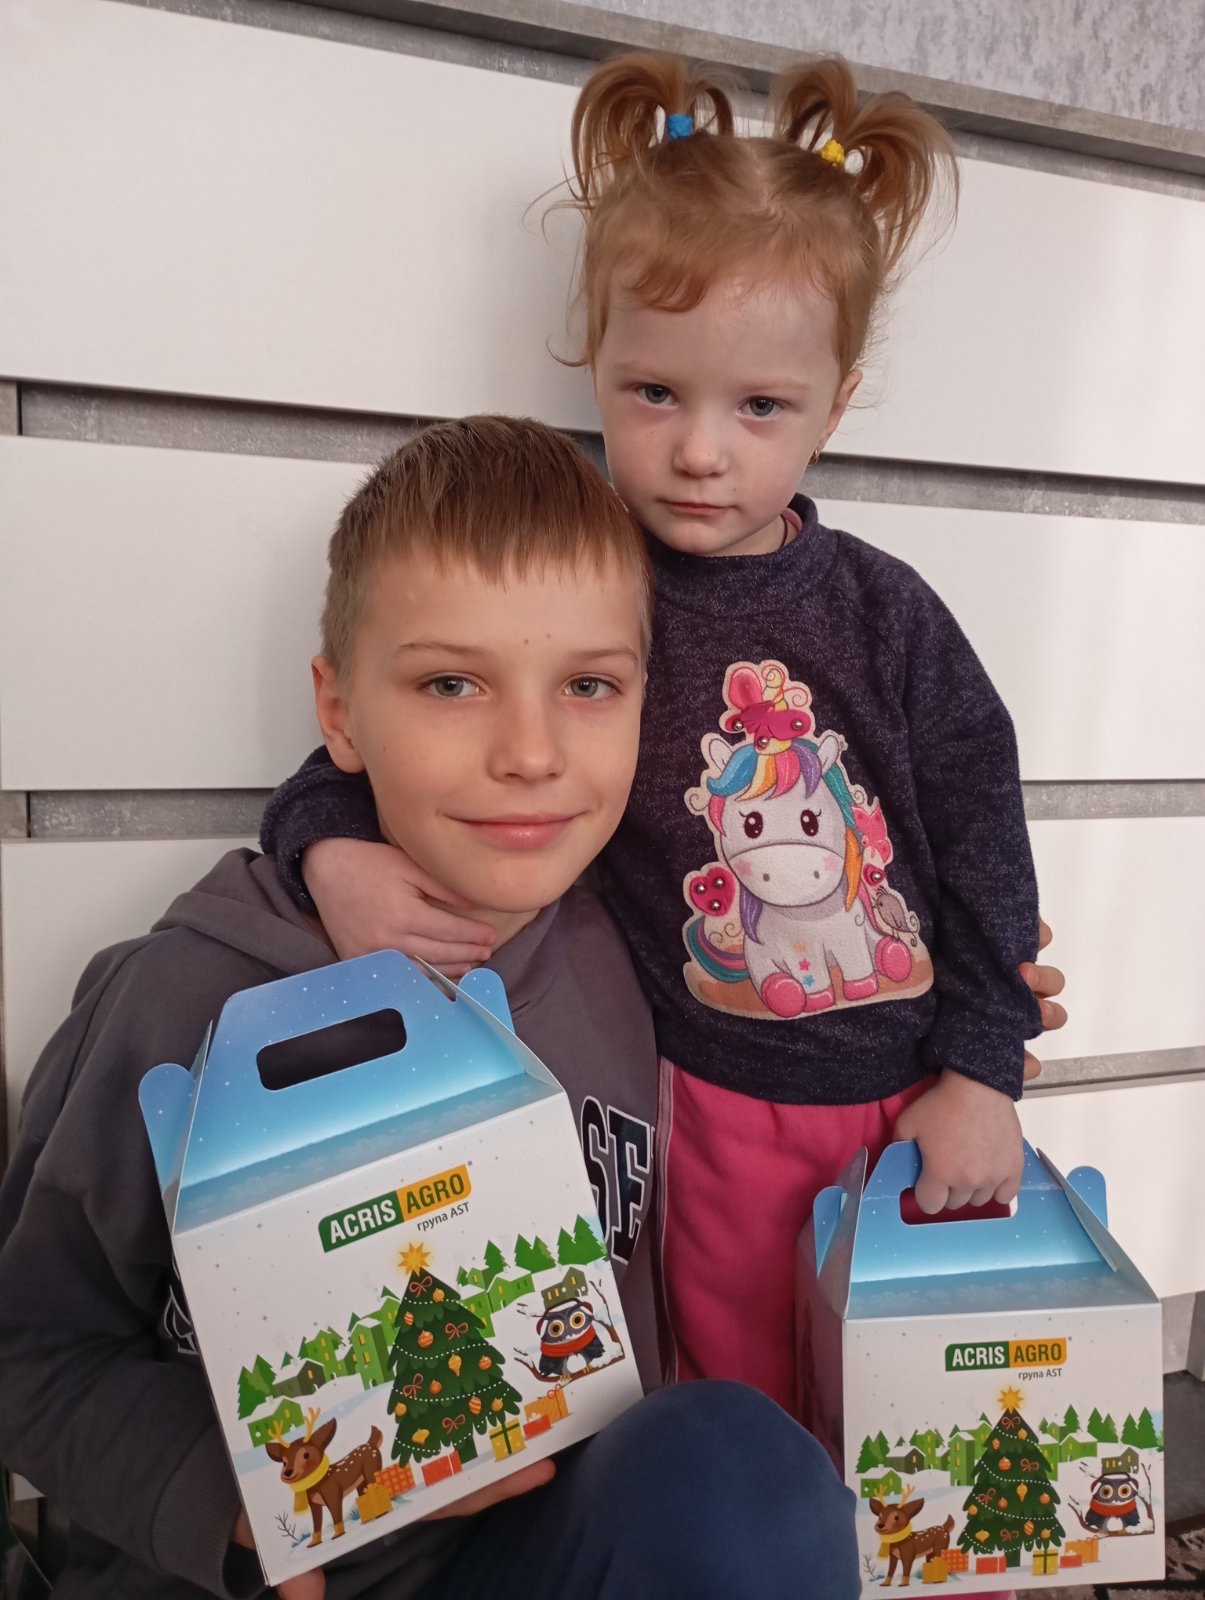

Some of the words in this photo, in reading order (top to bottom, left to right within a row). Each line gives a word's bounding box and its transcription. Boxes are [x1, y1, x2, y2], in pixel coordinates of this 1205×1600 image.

[330, 1199, 397, 1244] ACRIS
[406, 1173, 465, 1214] AGRO
[416, 1212, 449, 1232] група
[450, 1201, 470, 1219] AST
[952, 1346, 1005, 1367] ACRIS
[1013, 1343, 1062, 1363] AGRO
[1018, 1371, 1044, 1381] група
[1046, 1368, 1063, 1378] AST
